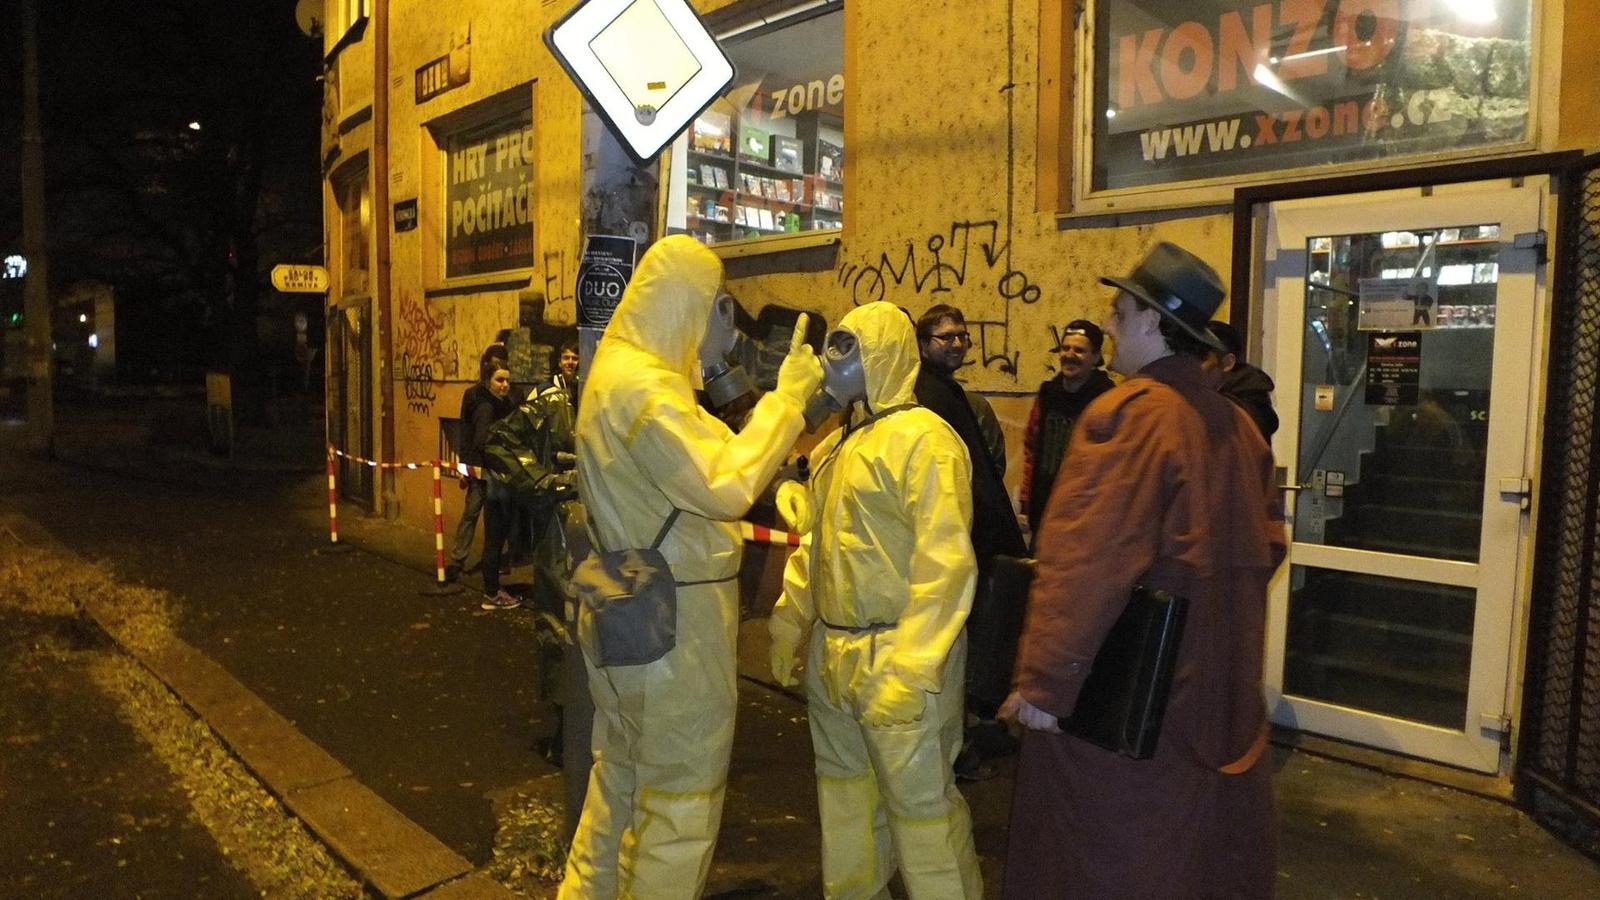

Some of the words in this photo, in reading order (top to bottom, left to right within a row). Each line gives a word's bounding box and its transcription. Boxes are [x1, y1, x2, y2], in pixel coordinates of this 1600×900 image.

[770, 74, 844, 120] zone
[1140, 87, 1454, 162] www.xzone.cz
[453, 143, 488, 185] HRY
[496, 129, 534, 173] PRO
[585, 281, 620, 297] DUO
